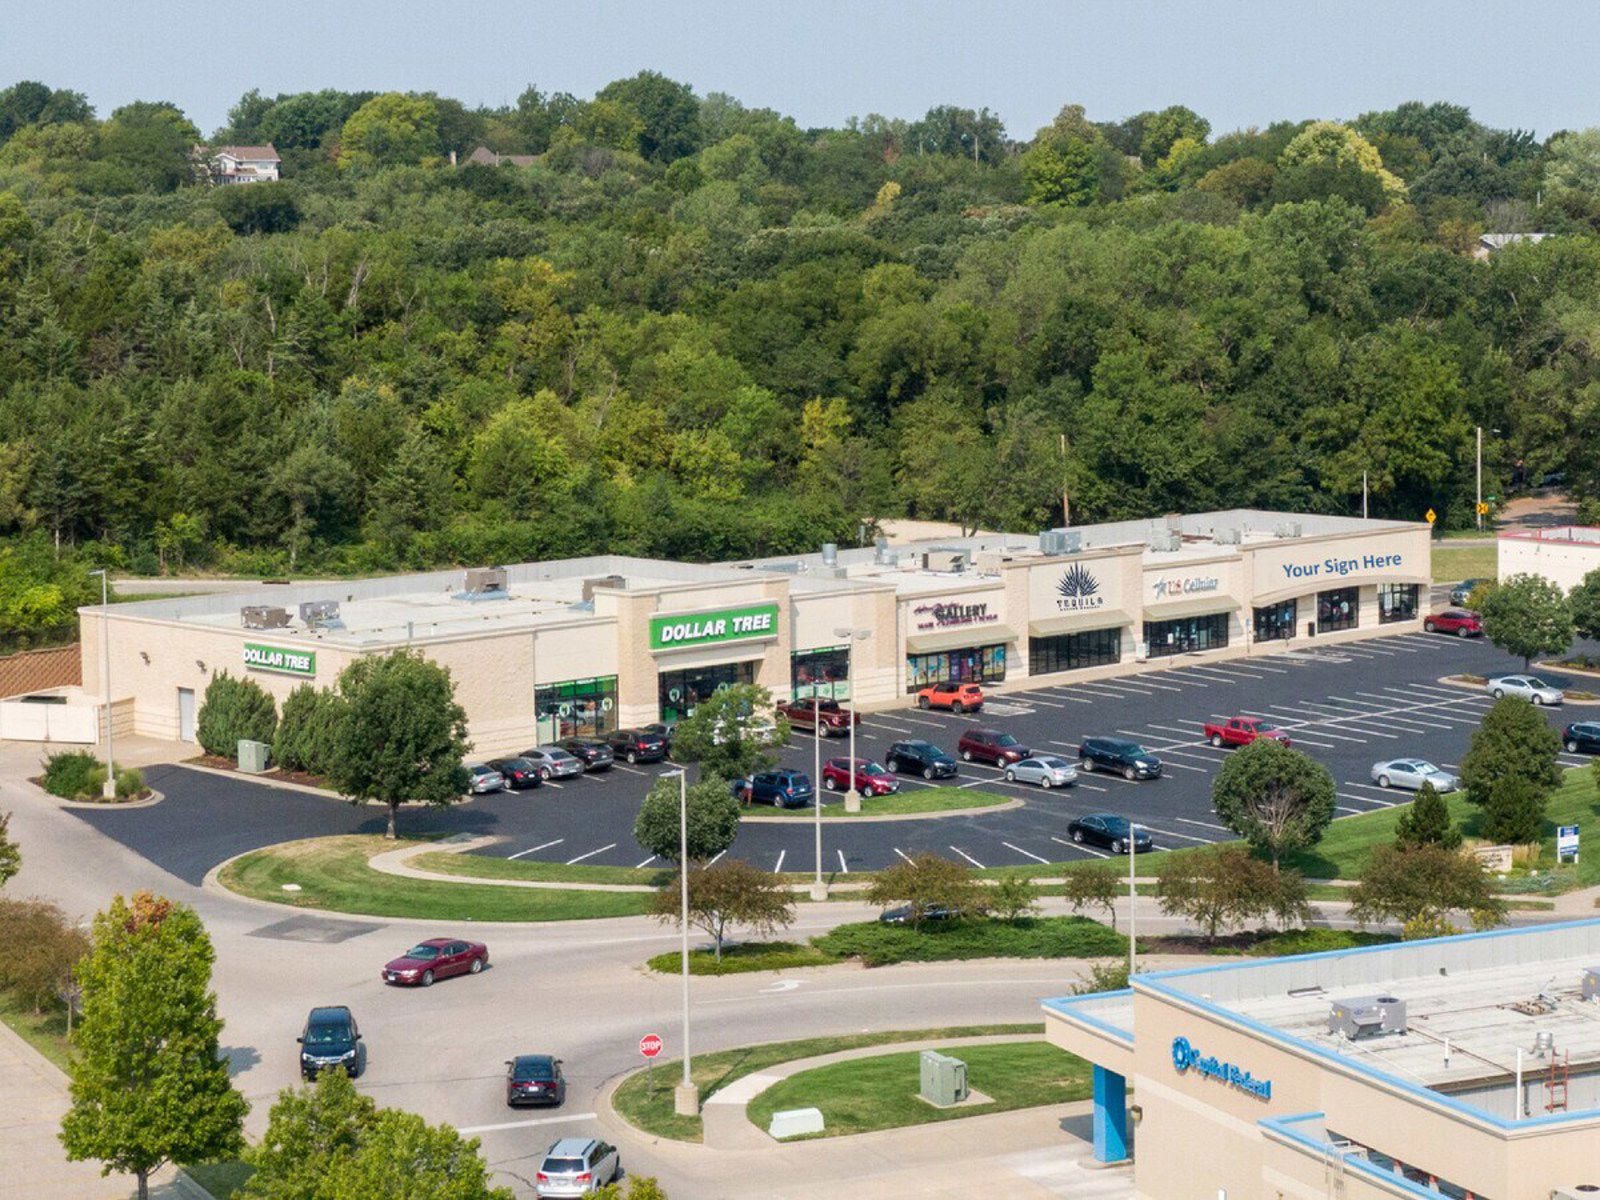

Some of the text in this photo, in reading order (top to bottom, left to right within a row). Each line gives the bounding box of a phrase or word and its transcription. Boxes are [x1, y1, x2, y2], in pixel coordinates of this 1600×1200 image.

[1283, 554, 1402, 578] Your Sign Here
[933, 603, 987, 621] GALLERY
[661, 613, 772, 642] DOLLAR TREE
[243, 648, 310, 670] DOLLAR TREE
[641, 1040, 662, 1051] STOP
[1230, 1064, 1271, 1099] Federal
